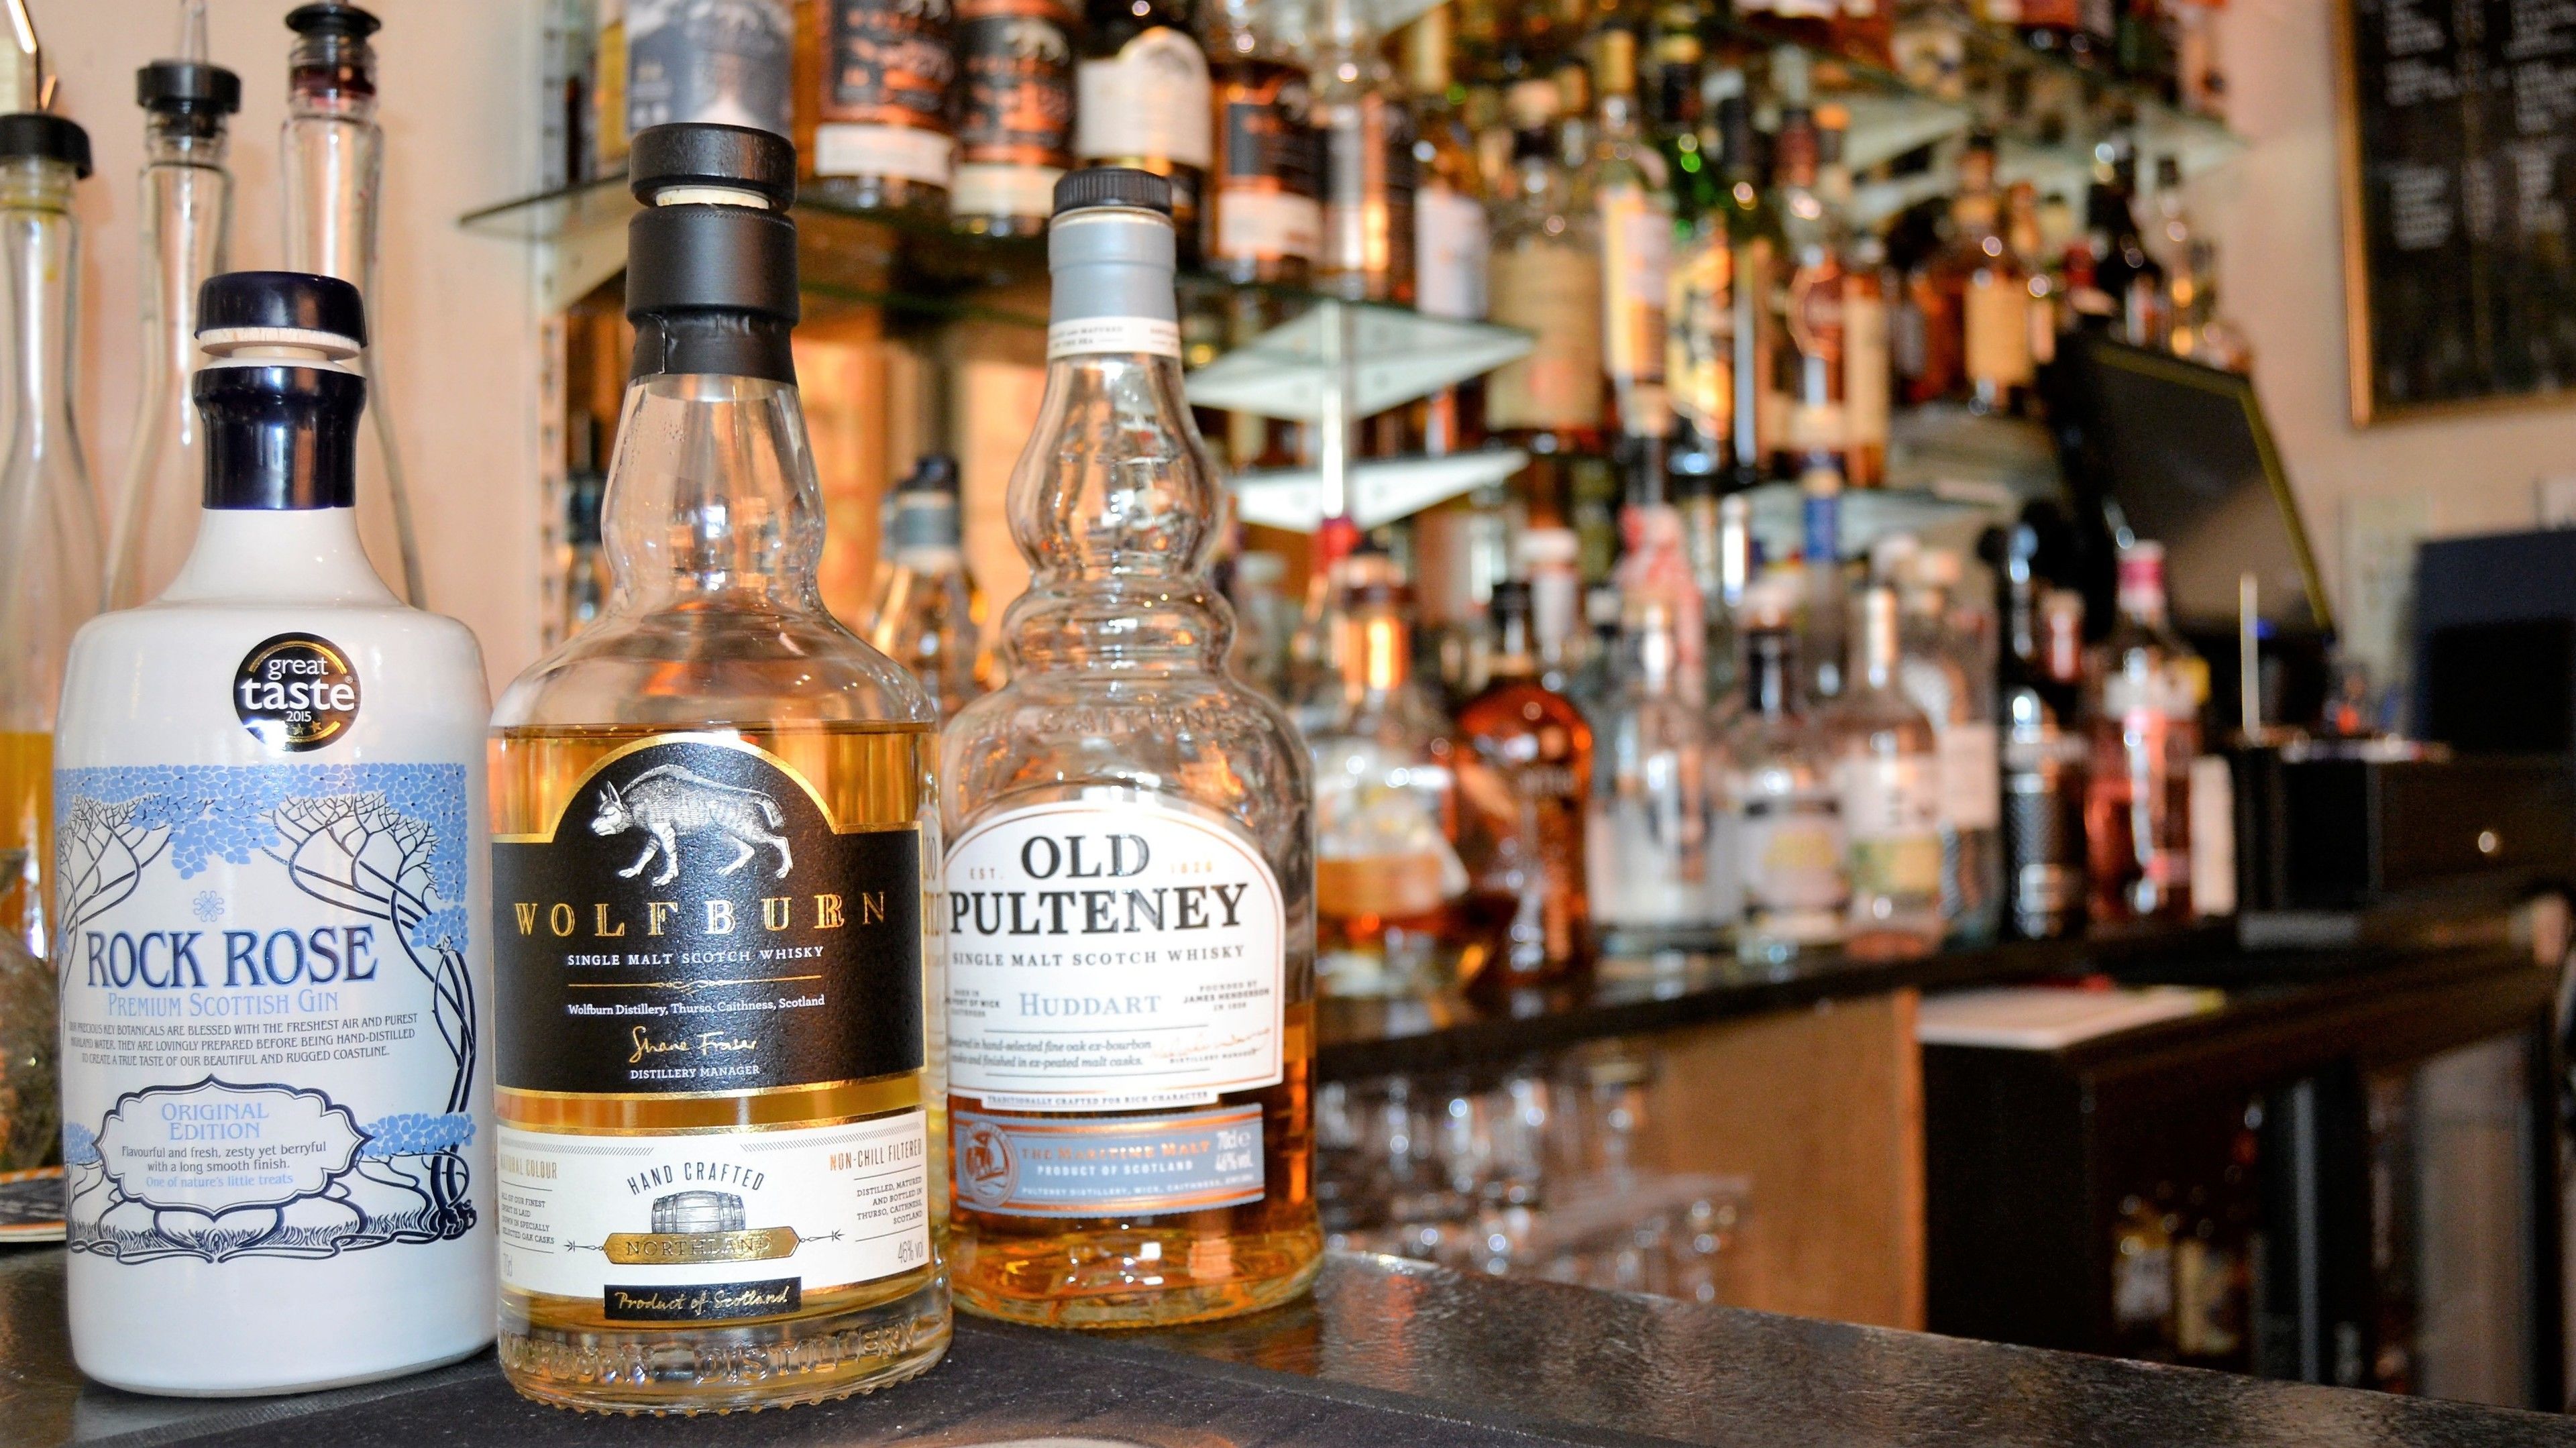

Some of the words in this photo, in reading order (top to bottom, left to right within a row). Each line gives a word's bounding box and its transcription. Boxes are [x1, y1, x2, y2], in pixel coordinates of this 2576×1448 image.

[268, 657, 329, 680] great
[241, 678, 354, 711] taste
[286, 711, 312, 722] 2015
[1021, 834, 1150, 880] OLD
[970, 868, 1003, 879] EST.
[515, 891, 885, 937] WOLFBURN
[950, 883, 1248, 935] PULTENEY
[86, 930, 209, 990] ROCK
[223, 924, 378, 987] ROSE
[568, 954, 620, 966] SINGLE
[628, 953, 672, 965] MALT
[682, 950, 751, 964] SCOTCH
[759, 946, 824, 960] WHISKY
[953, 952, 1004, 966] SINGLE
[1012, 954, 1063, 966] MALT
[1073, 950, 1157, 966] SCOTCH
[1168, 945, 1245, 963] WHISKY
[568, 1005, 613, 1015] Wolfburn
[616, 1005, 669, 1016] Distillery,
[671, 1003, 715, 1015] Thurso,
[717, 999, 777, 1012] Caithness,
[779, 994, 825, 1008] Scotland
[1183, 994, 1215, 1003] JAMES
[104, 1025, 115, 1035] KEY
[117, 1025, 164, 1036] BOTANICALS
[168, 1025, 184, 1036] ARE
[188, 1025, 231, 1035] BLESSED
[235, 1024, 260, 1034] WITH
[263, 1023, 283, 1033] THE
[287, 1019, 339, 1032] FRESHEST
[342, 1019, 359, 1029] AIR
[362, 1017, 382, 1027] AND
[385, 1013, 417, 1025] PUREST
[118, 1040, 136, 1050] THEY
[137, 1041, 154, 1050] ARE
[156, 1041, 199, 1051] LOVINGLY
[201, 1040, 253, 1051] PREPARED
[256, 1038, 298, 1049] BEFORE
[302, 1035, 333, 1046] BEING
[337, 1028, 415, 1044] HAND-DISTILLED
[1044, 1041, 1064, 1054] fine
[1067, 1040, 1086, 1051] oak
[82, 1053, 89, 1063] TO
[89, 1054, 111, 1064] CREATE
[112, 1054, 117, 1065] A
[119, 1055, 137, 1066] TRUE
[140, 1056, 164, 1066] TASTE
[166, 1056, 177, 1066] OF
[180, 1056, 201, 1066] OUR
[204, 1054, 258, 1066] BEAUTIFUL
[261, 1054, 282, 1064] AND
[286, 1051, 330, 1063] RUGGED
[333, 1046, 390, 1060] COASTLINE.
[631, 1068, 696, 1079] DISTILLERY
[700, 1065, 759, 1077] MANAGER
[1055, 1097, 1098, 1105] CRAFTED
[1152, 1091, 1208, 1102] CHARACTER
[168, 1146, 186, 1158] and
[191, 1146, 221, 1158] fresh,
[225, 1146, 254, 1159] zesty
[259, 1146, 276, 1158] yet
[280, 1141, 326, 1157] berryful
[830, 1148, 885, 1171] NON-CHILL
[888, 1138, 922, 1162] FILTERED
[148, 1162, 167, 1172] with
[171, 1164, 176, 1172] a
[180, 1161, 203, 1174] long
[207, 1160, 250, 1172] smooth
[254, 1158, 289, 1170] finish.
[526, 1159, 557, 1179] COLOUR
[1037, 1166, 1095, 1176] PRODUCT
[1102, 1165, 1118, 1175] OF
[1124, 1160, 1193, 1174] SCOTLAND
[146, 1177, 164, 1187] One
[168, 1176, 177, 1187] of
[181, 1177, 223, 1187] nature's
[228, 1176, 254, 1186] little
[259, 1174, 293, 1185] treats
[627, 1165, 674, 1196] HAND
[684, 1162, 764, 1190] CRAFTED
[857, 1184, 895, 1196] DISTILLED,
[896, 1176, 922, 1189] MATURED
[526, 1198, 545, 1207] FINEST
[873, 1196, 888, 1206] AND
[890, 1190, 916, 1203] BOTTLED
[519, 1209, 531, 1217] LAID
[857, 1209, 889, 1220] THURSO,
[894, 1211, 922, 1224] SCOTLAND
[520, 1221, 549, 1232] SPECIALLY
[522, 1233, 533, 1241] OAK
[535, 1235, 555, 1245] CASKS
[627, 1235, 772, 1256] NORTHLAND
[615, 1292, 686, 1310] Product
[691, 1290, 707, 1315] of
[714, 1285, 790, 1307] Scotland
